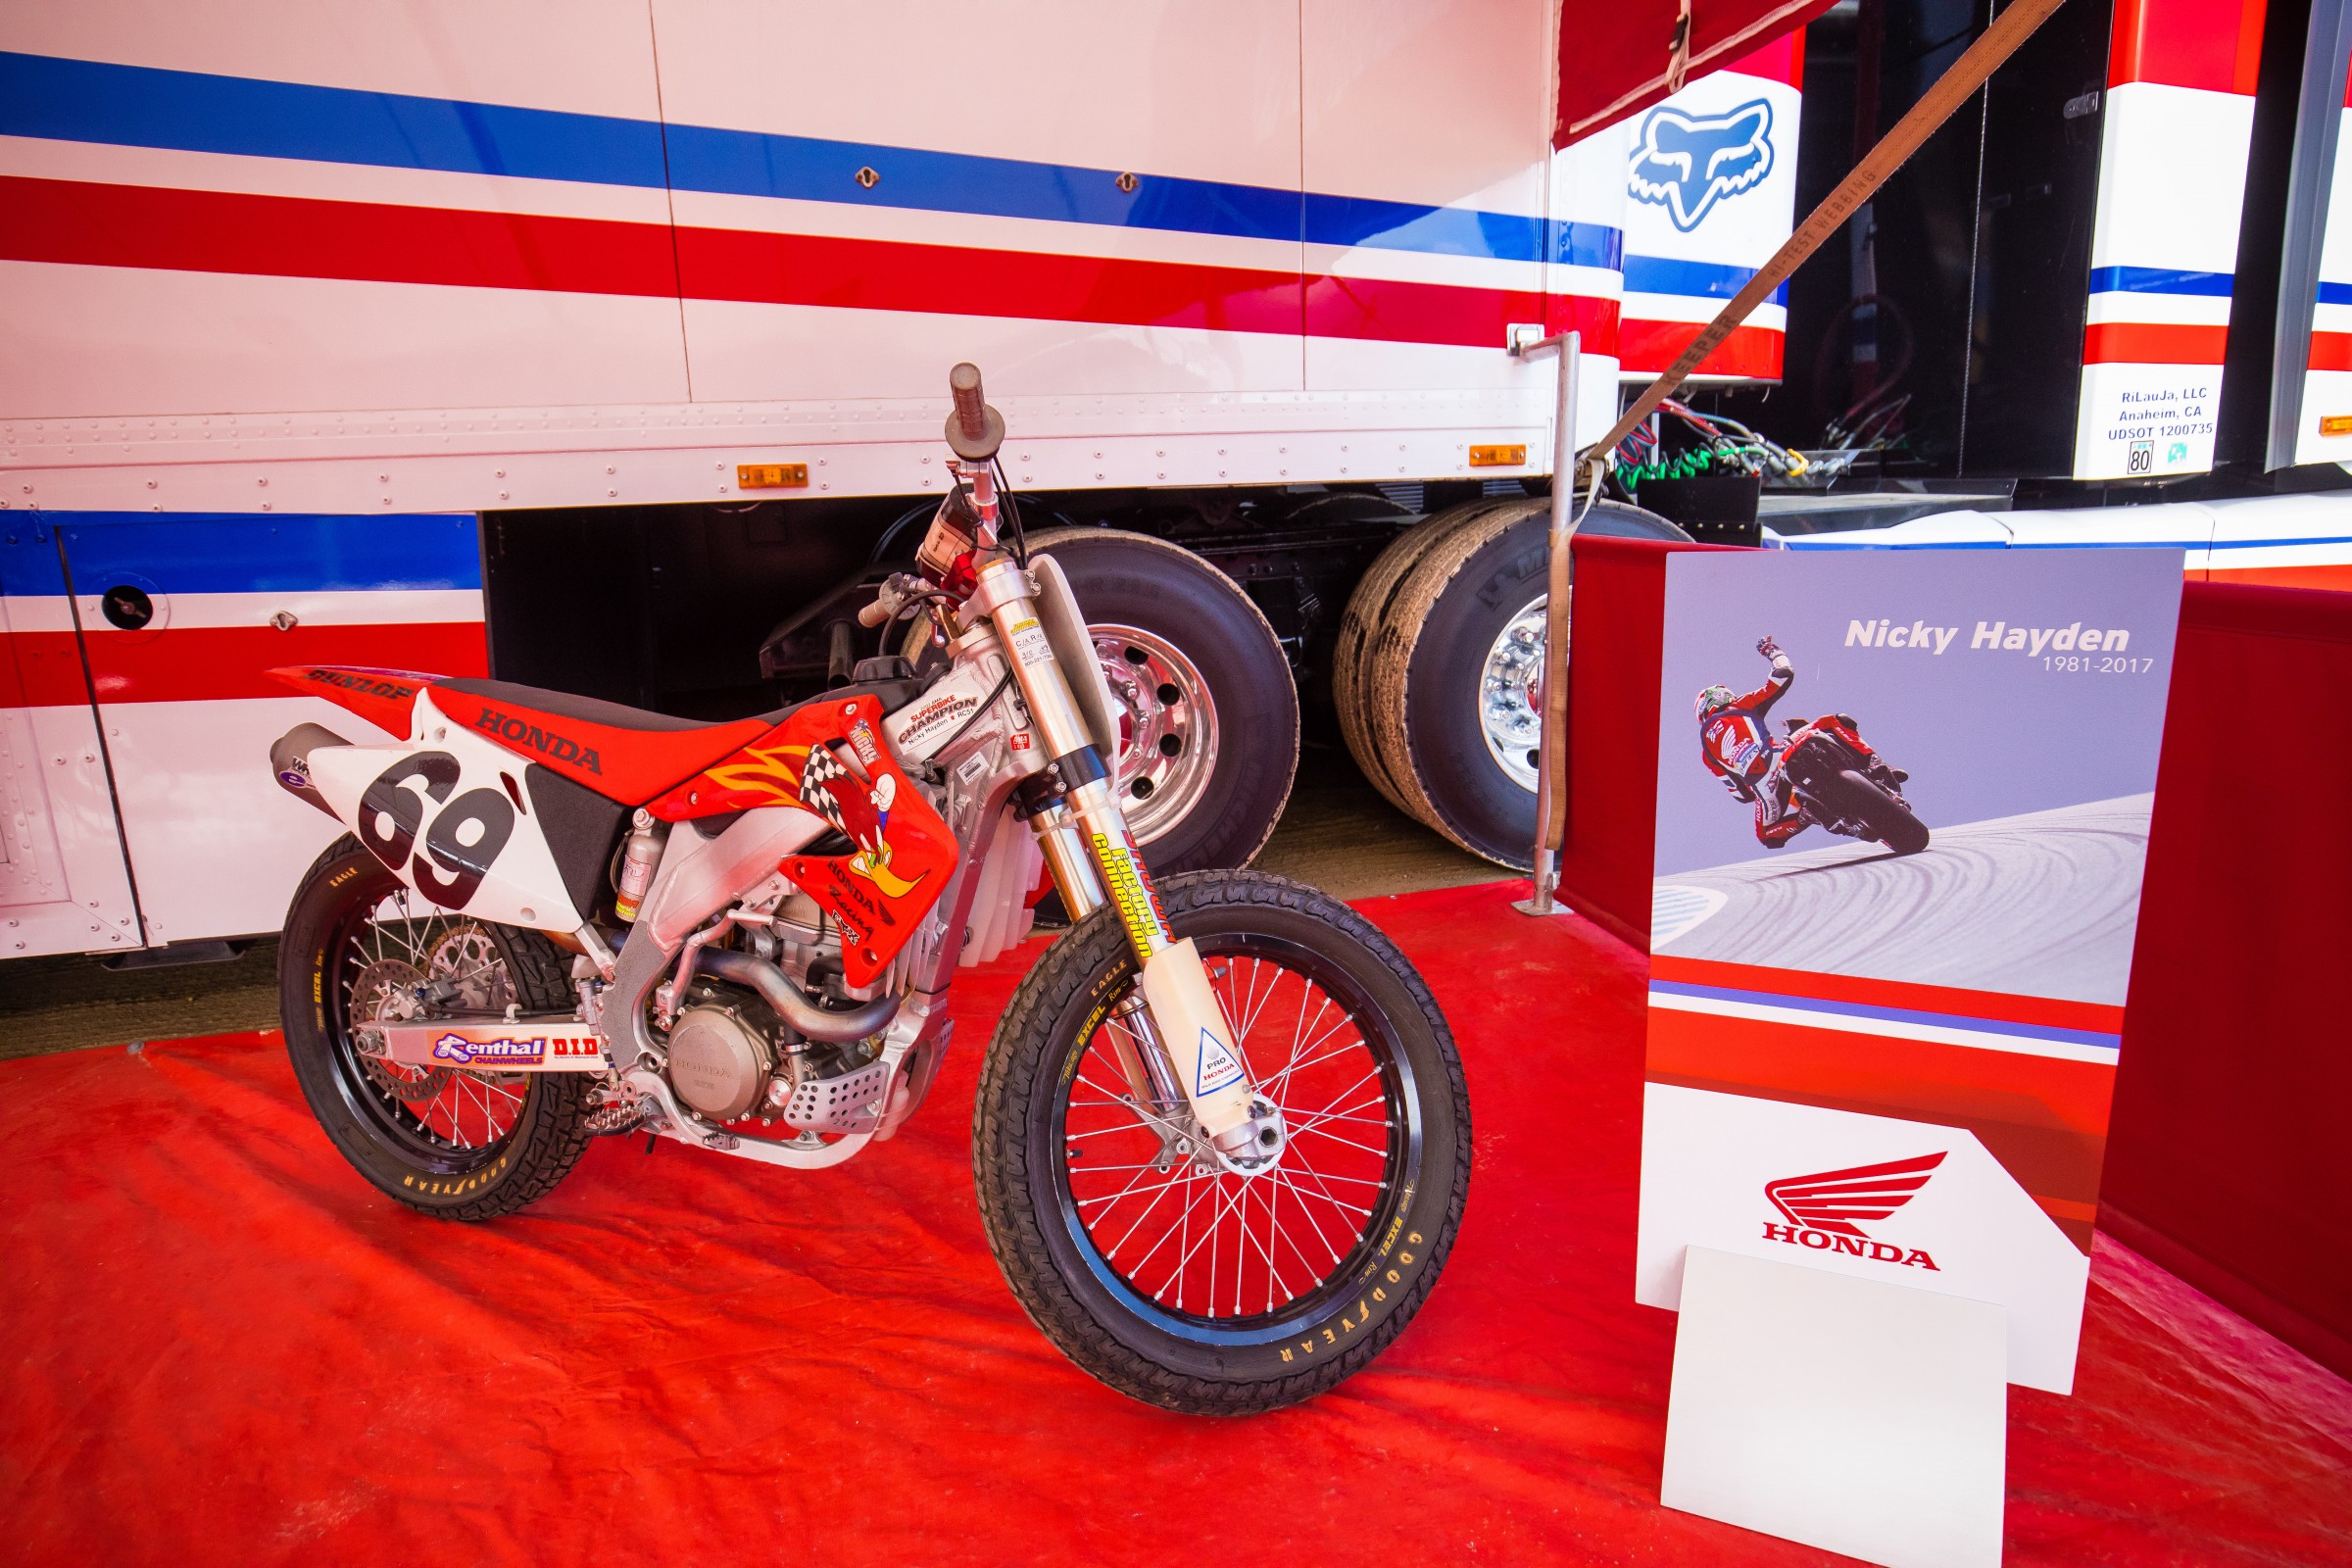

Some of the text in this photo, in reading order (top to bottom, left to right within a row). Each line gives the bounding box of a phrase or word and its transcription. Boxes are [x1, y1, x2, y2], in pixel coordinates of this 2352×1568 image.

[1815, 171, 1877, 229] WEBBING
[1664, 314, 1739, 387] KEEPER
[2119, 406, 2201, 421] Anaheim, CA
[2122, 387, 2207, 403] RiLauJa, LLC
[2108, 423, 2213, 440] UDSOT 1200735
[2131, 450, 2150, 471] 80
[1844, 619, 2130, 657] Nicky Hayden
[2042, 656, 2153, 673] 1981-2017
[304, 669, 415, 699] DUNLOP
[898, 697, 978, 745] CHAMPION
[907, 708, 974, 745] Nicky Hayden RC51
[910, 695, 956, 722] SUPERBIKE
[475, 708, 602, 775] HONDA
[1728, 737, 1751, 765] HONDA
[358, 751, 515, 910] 69
[329, 866, 359, 887] EAGLE
[827, 859, 875, 915] HONDA
[1092, 833, 1152, 957] connection
[1111, 848, 1159, 936] Factory
[1121, 830, 1177, 944] SHOWA
[829, 884, 874, 942] Racing
[1091, 960, 1127, 997] EAGLE
[1077, 1004, 1105, 1047] EXCEL
[438, 1034, 543, 1062] Renthal
[553, 1038, 599, 1055] D.I.D
[1206, 1056, 1226, 1070] PRO
[676, 1058, 733, 1079] HONDA
[1202, 1063, 1235, 1081] HONDA
[1379, 1216, 1403, 1256] EXCEL
[1762, 1221, 1940, 1271] HONDA
[1280, 1231, 1423, 1362] GOODYEAR
